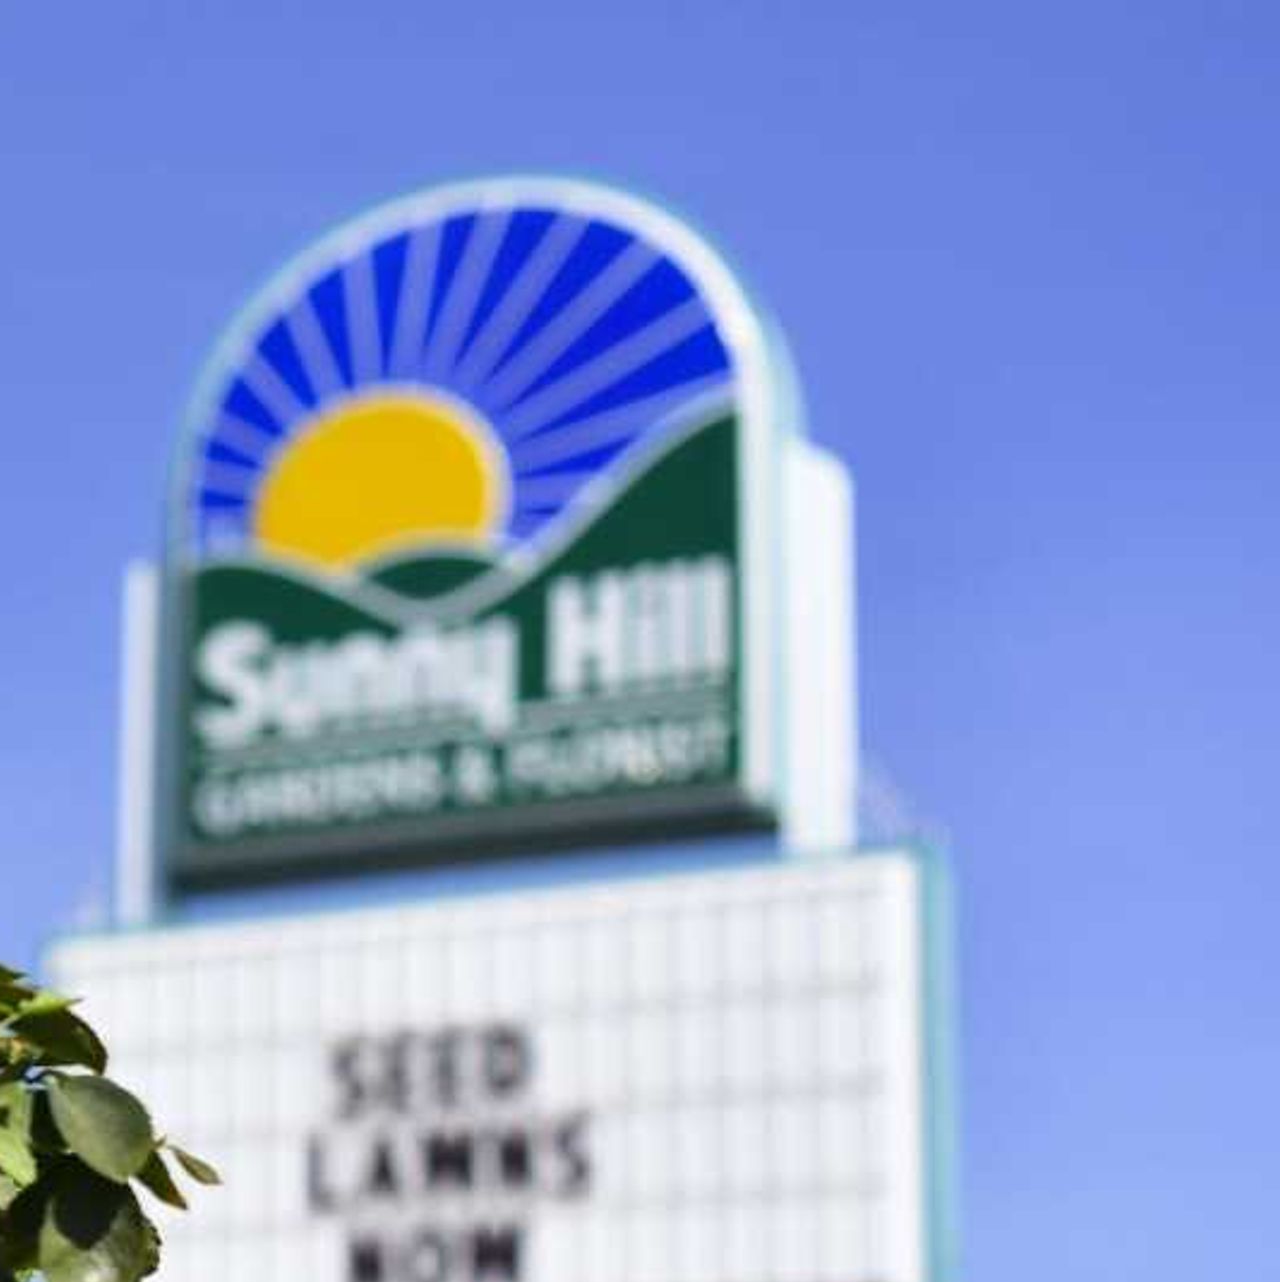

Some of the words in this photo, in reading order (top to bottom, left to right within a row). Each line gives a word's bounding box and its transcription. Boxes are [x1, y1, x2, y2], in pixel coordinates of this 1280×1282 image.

[197, 620, 518, 745] Sunny
[545, 555, 733, 695] Hill
[333, 1022, 530, 1118] SEED
[306, 1108, 592, 1206] LAWNS
